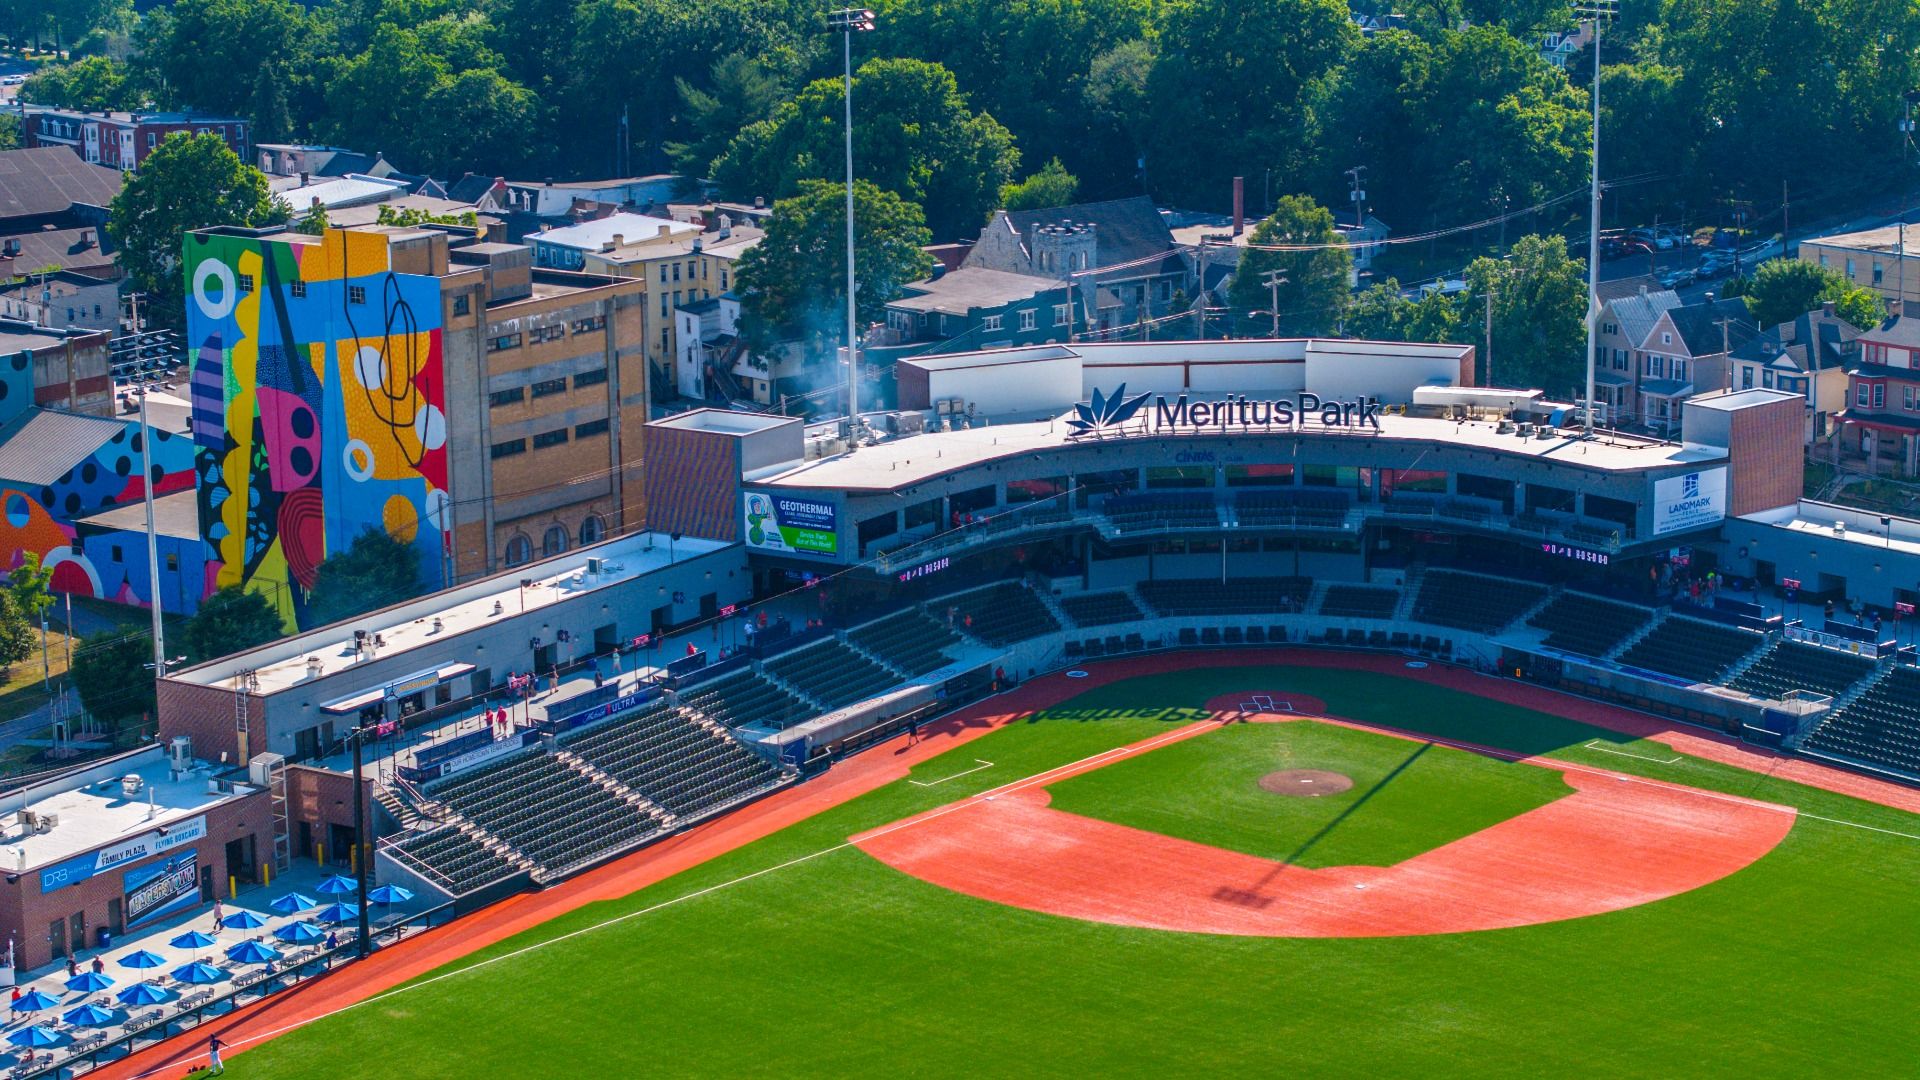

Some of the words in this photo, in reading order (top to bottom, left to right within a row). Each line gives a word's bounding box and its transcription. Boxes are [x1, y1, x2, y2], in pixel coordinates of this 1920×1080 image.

[1155, 393, 1294, 427] Meritus
[1298, 392, 1379, 428] Park
[780, 500, 834, 517] GEOTHERMAL
[1669, 496, 1711, 514] LANDMARK
[612, 696, 636, 712] ULTRA
[155, 836, 174, 850] FLYING
[174, 827, 200, 843] BOXCARS!
[101, 851, 124, 866] FAMILY
[125, 844, 146, 858] PLAZA
[44, 868, 68, 887] DRB
